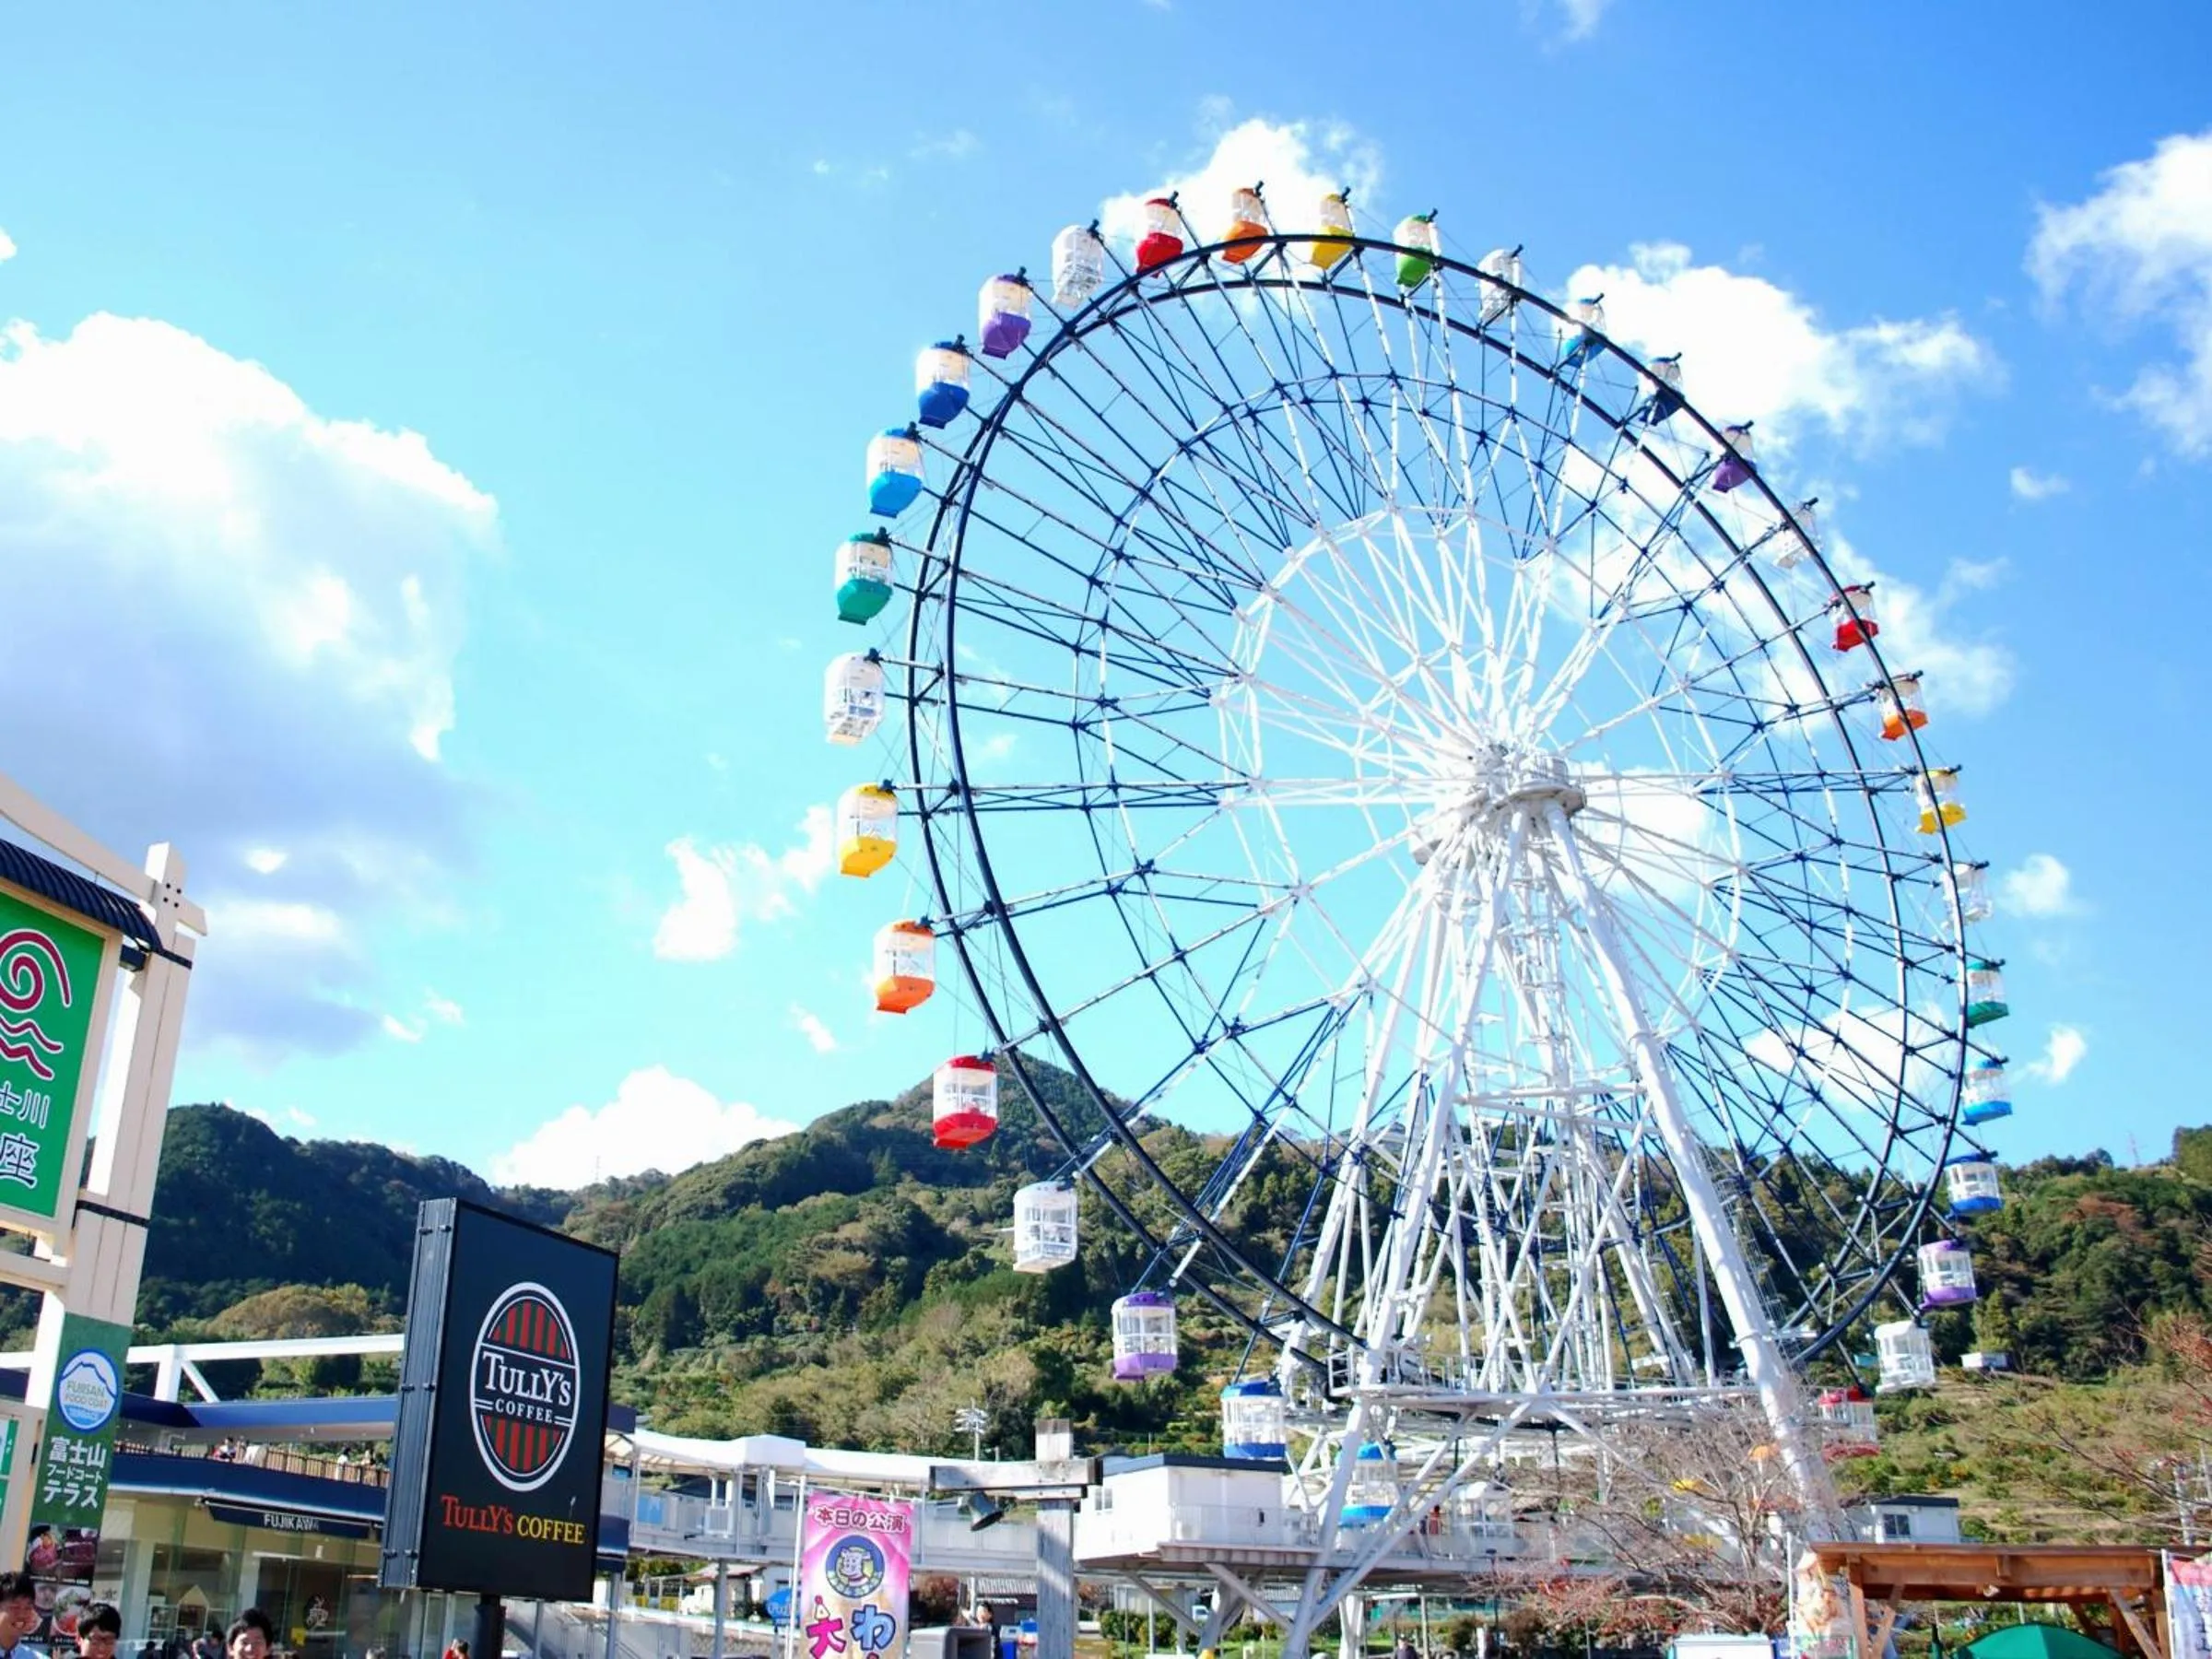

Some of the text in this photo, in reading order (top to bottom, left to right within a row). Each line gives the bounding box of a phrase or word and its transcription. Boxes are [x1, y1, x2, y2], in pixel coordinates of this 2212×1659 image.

[0, 1133, 39, 1189] 座
[482, 1350, 571, 1406] TULLY'S
[495, 1398, 552, 1423] COFFEE
[49, 1436, 107, 1468] 富士山
[47, 1464, 102, 1485] フードコート
[43, 1479, 99, 1509] テラス
[441, 1494, 585, 1544] TULLY'S COFFEE
[815, 1506, 905, 1532] 本日の公演
